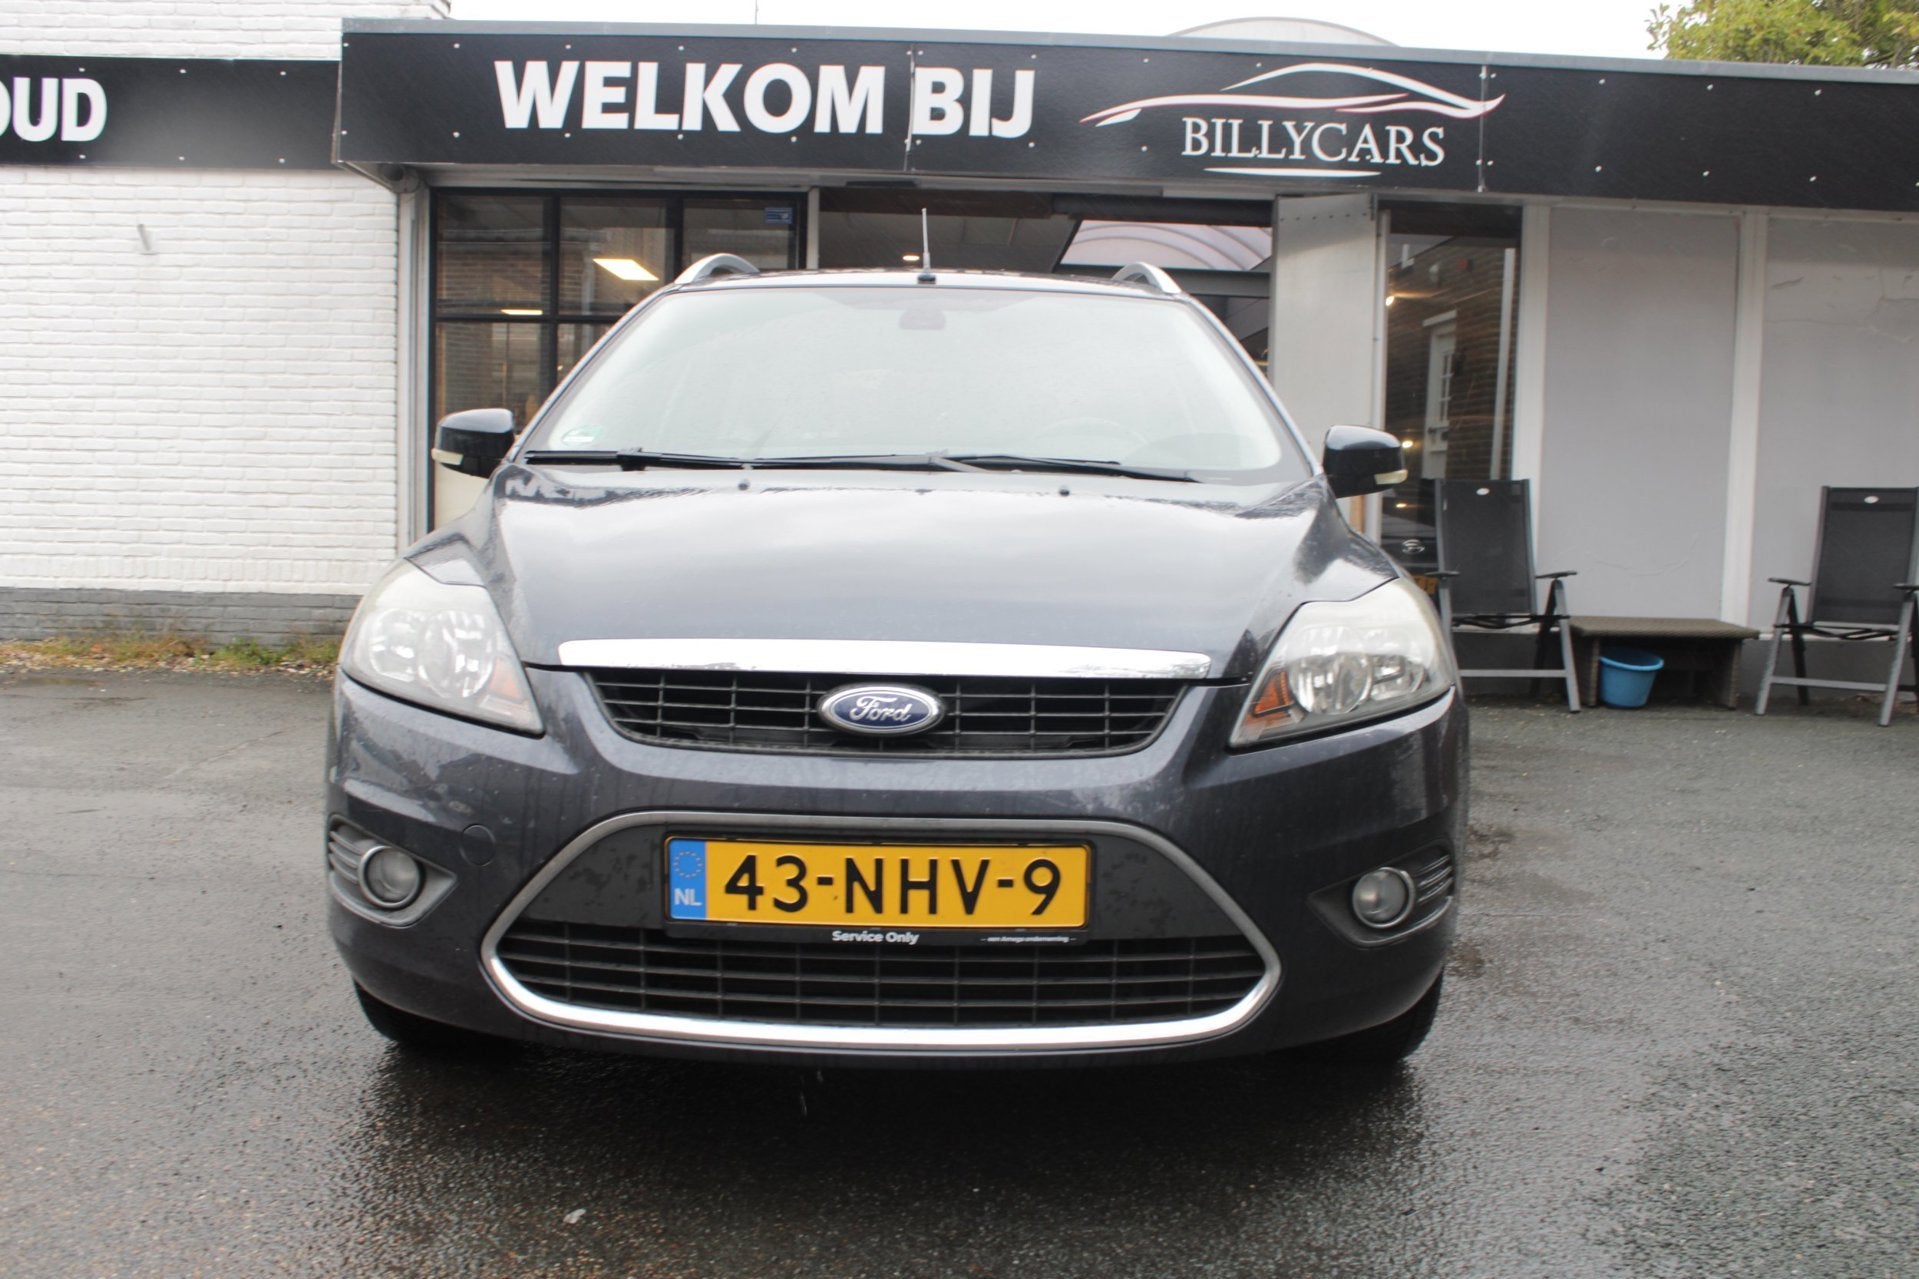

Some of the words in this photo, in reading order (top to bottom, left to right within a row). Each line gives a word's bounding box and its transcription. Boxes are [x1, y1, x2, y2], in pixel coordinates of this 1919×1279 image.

[0, 76, 108, 142] UD
[494, 60, 885, 134] WELKOM
[911, 67, 1035, 138] BIJ
[1181, 116, 1446, 167] BILLYCARS
[849, 695, 912, 722] Ford
[674, 888, 701, 906] NL
[724, 854, 1062, 916] 43-NHV-9
[832, 930, 881, 944] Service
[885, 931, 919, 946] Only
